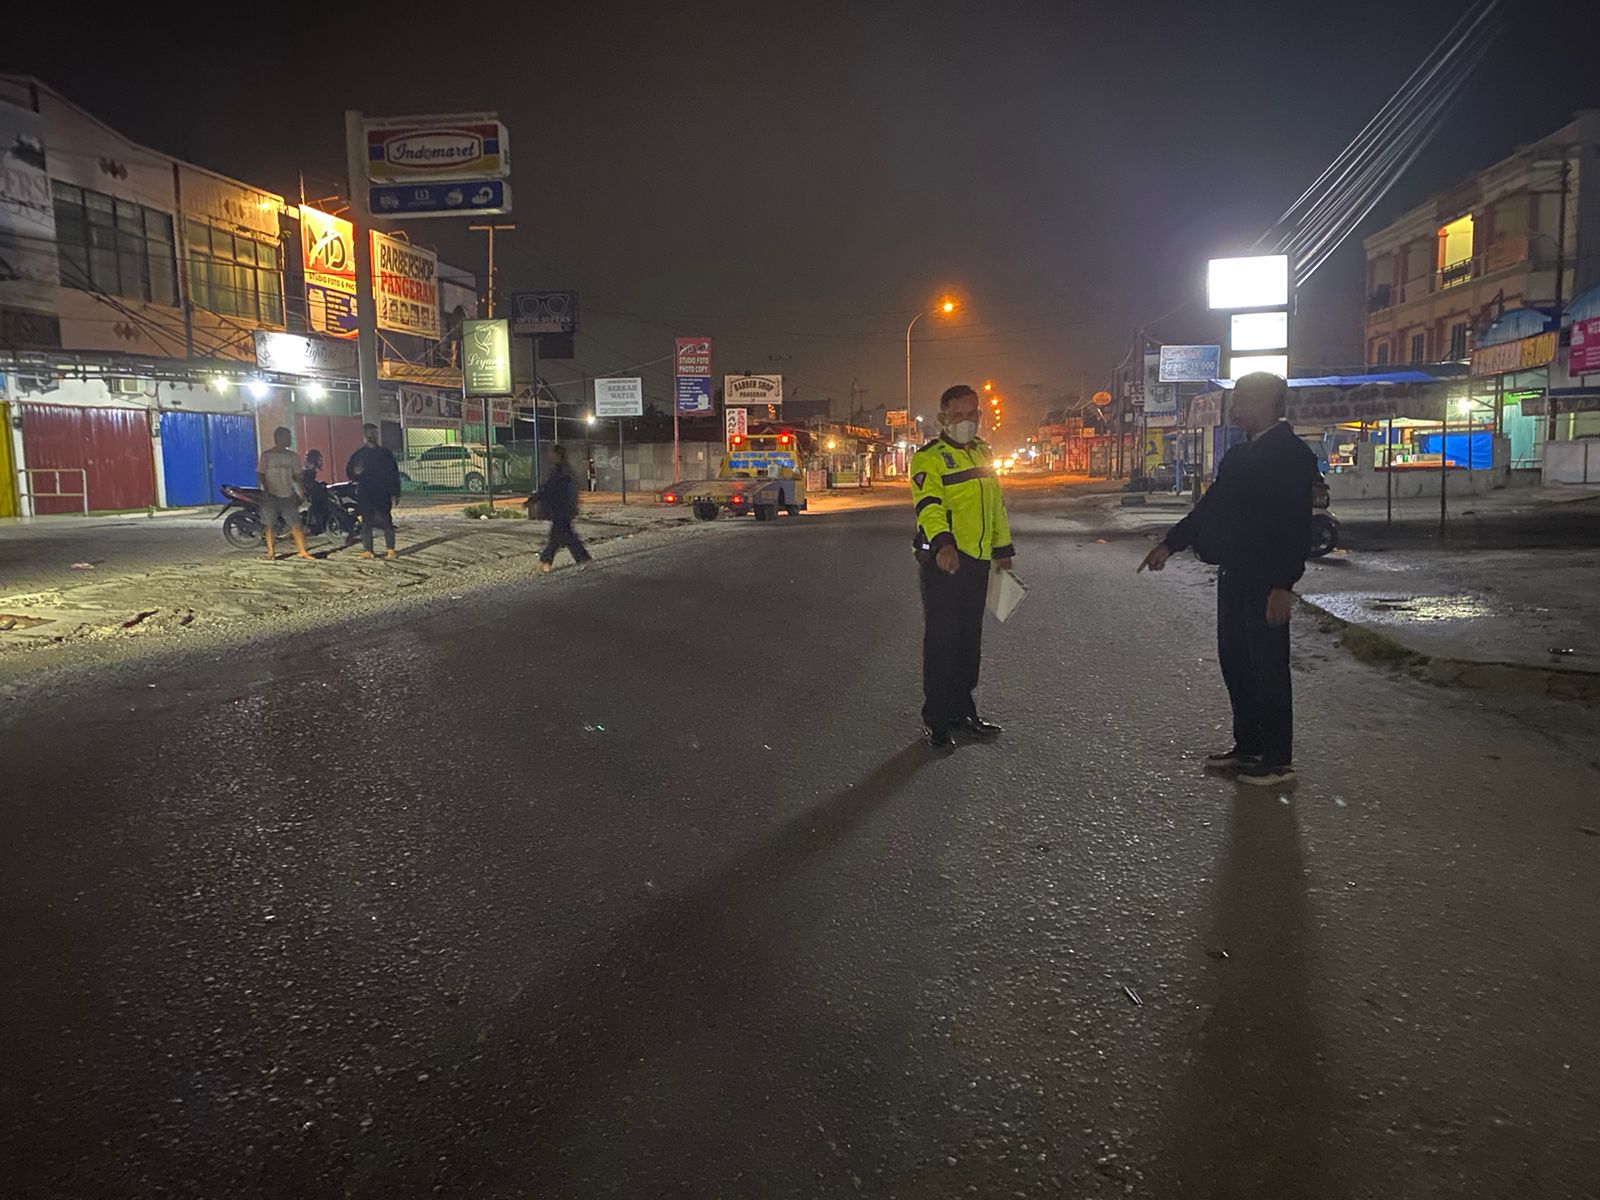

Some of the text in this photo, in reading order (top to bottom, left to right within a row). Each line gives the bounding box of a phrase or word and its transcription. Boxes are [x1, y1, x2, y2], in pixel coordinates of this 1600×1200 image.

[392, 141, 476, 161] Indomaret
[380, 243, 434, 281] BARBERSHOP
[308, 273, 327, 284] STUDIO
[327, 277, 341, 287] FOTO
[380, 270, 437, 306] PANGERAN
[697, 356, 709, 364] FOTO
[679, 365, 708, 373] PHOTO COPY
[608, 384, 637, 392] BERKAH
[733, 380, 775, 392] BARBER SHOP
[610, 392, 636, 400] WATER
